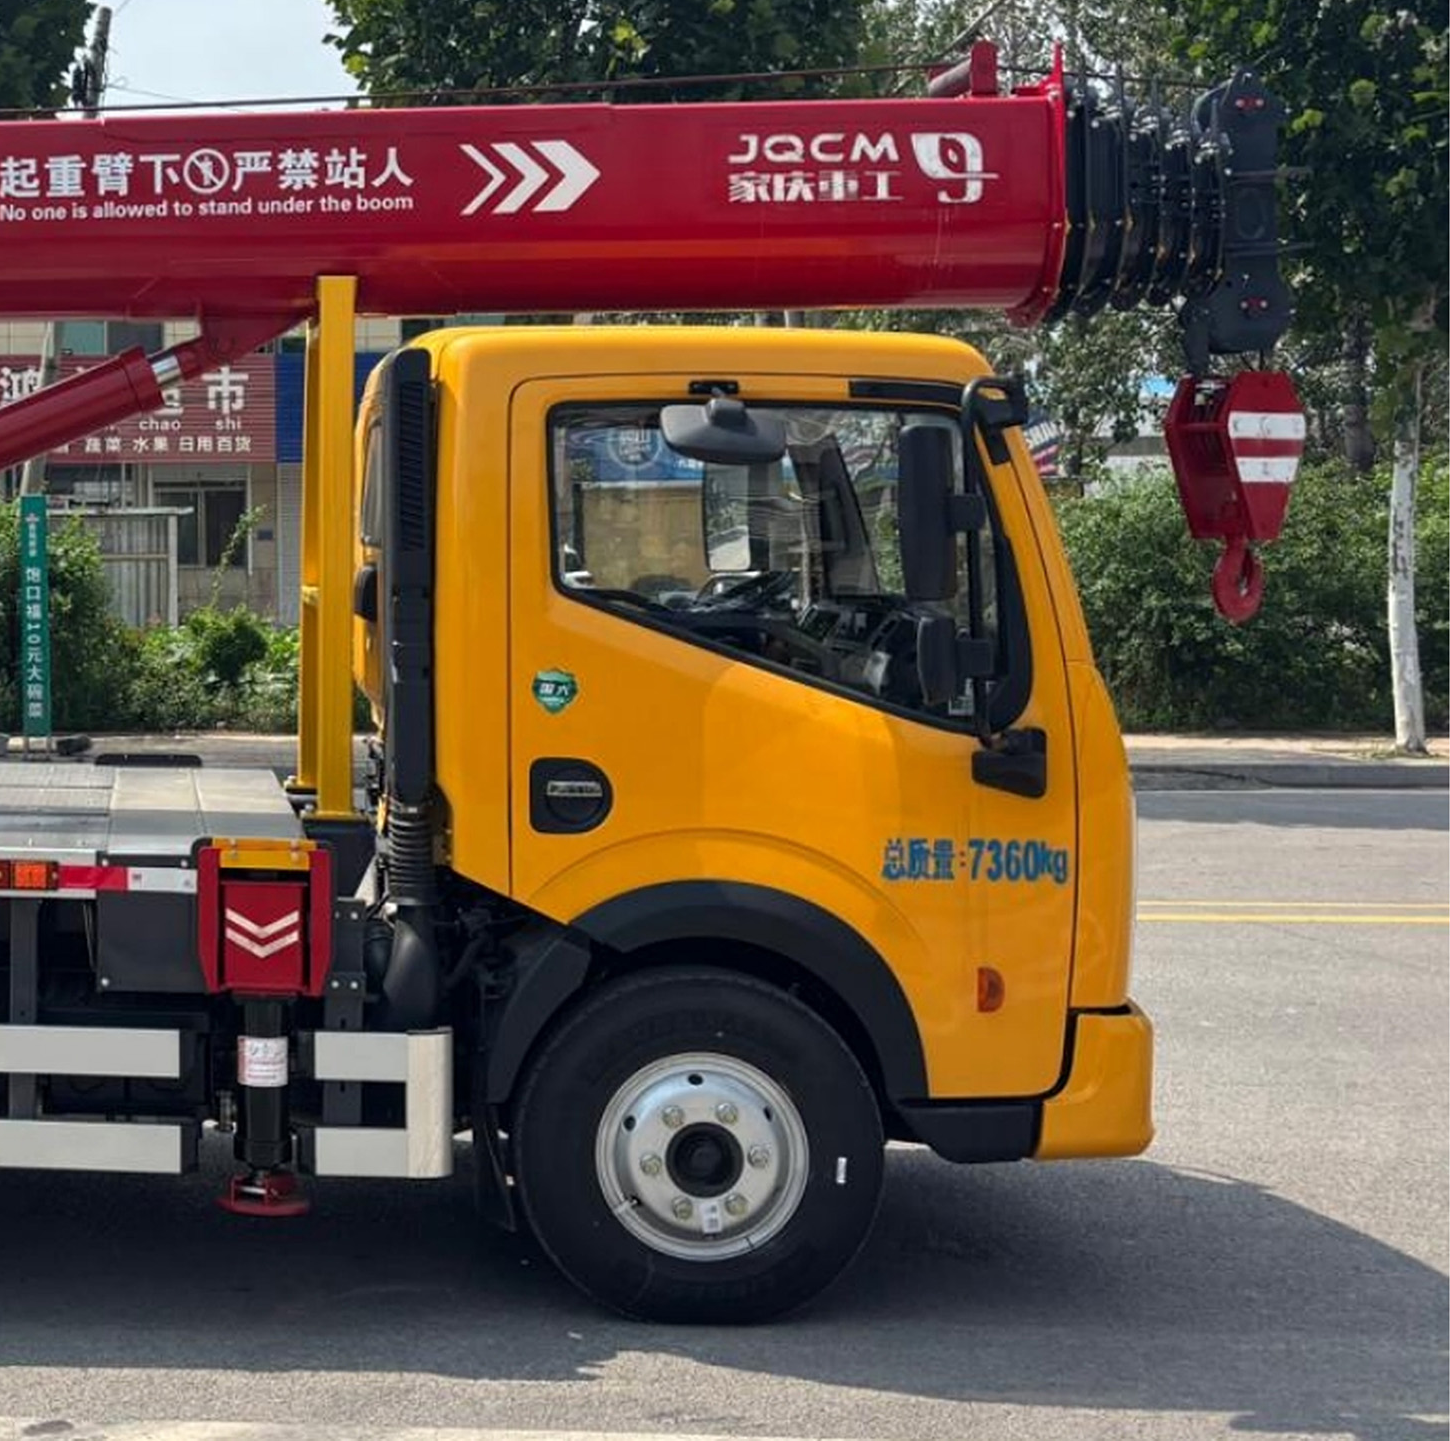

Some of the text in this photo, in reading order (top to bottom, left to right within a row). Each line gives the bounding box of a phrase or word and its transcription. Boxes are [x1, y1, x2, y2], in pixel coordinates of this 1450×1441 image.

[728, 133, 899, 164] JQCM
[0, 147, 413, 198] 起重臂下 严禁站人
[0, 194, 413, 221] No one is allowed to stand under the boom
[139, 417, 242, 431] chao shi
[132, 436, 169, 453] 水果
[179, 436, 251, 453] 日用百货
